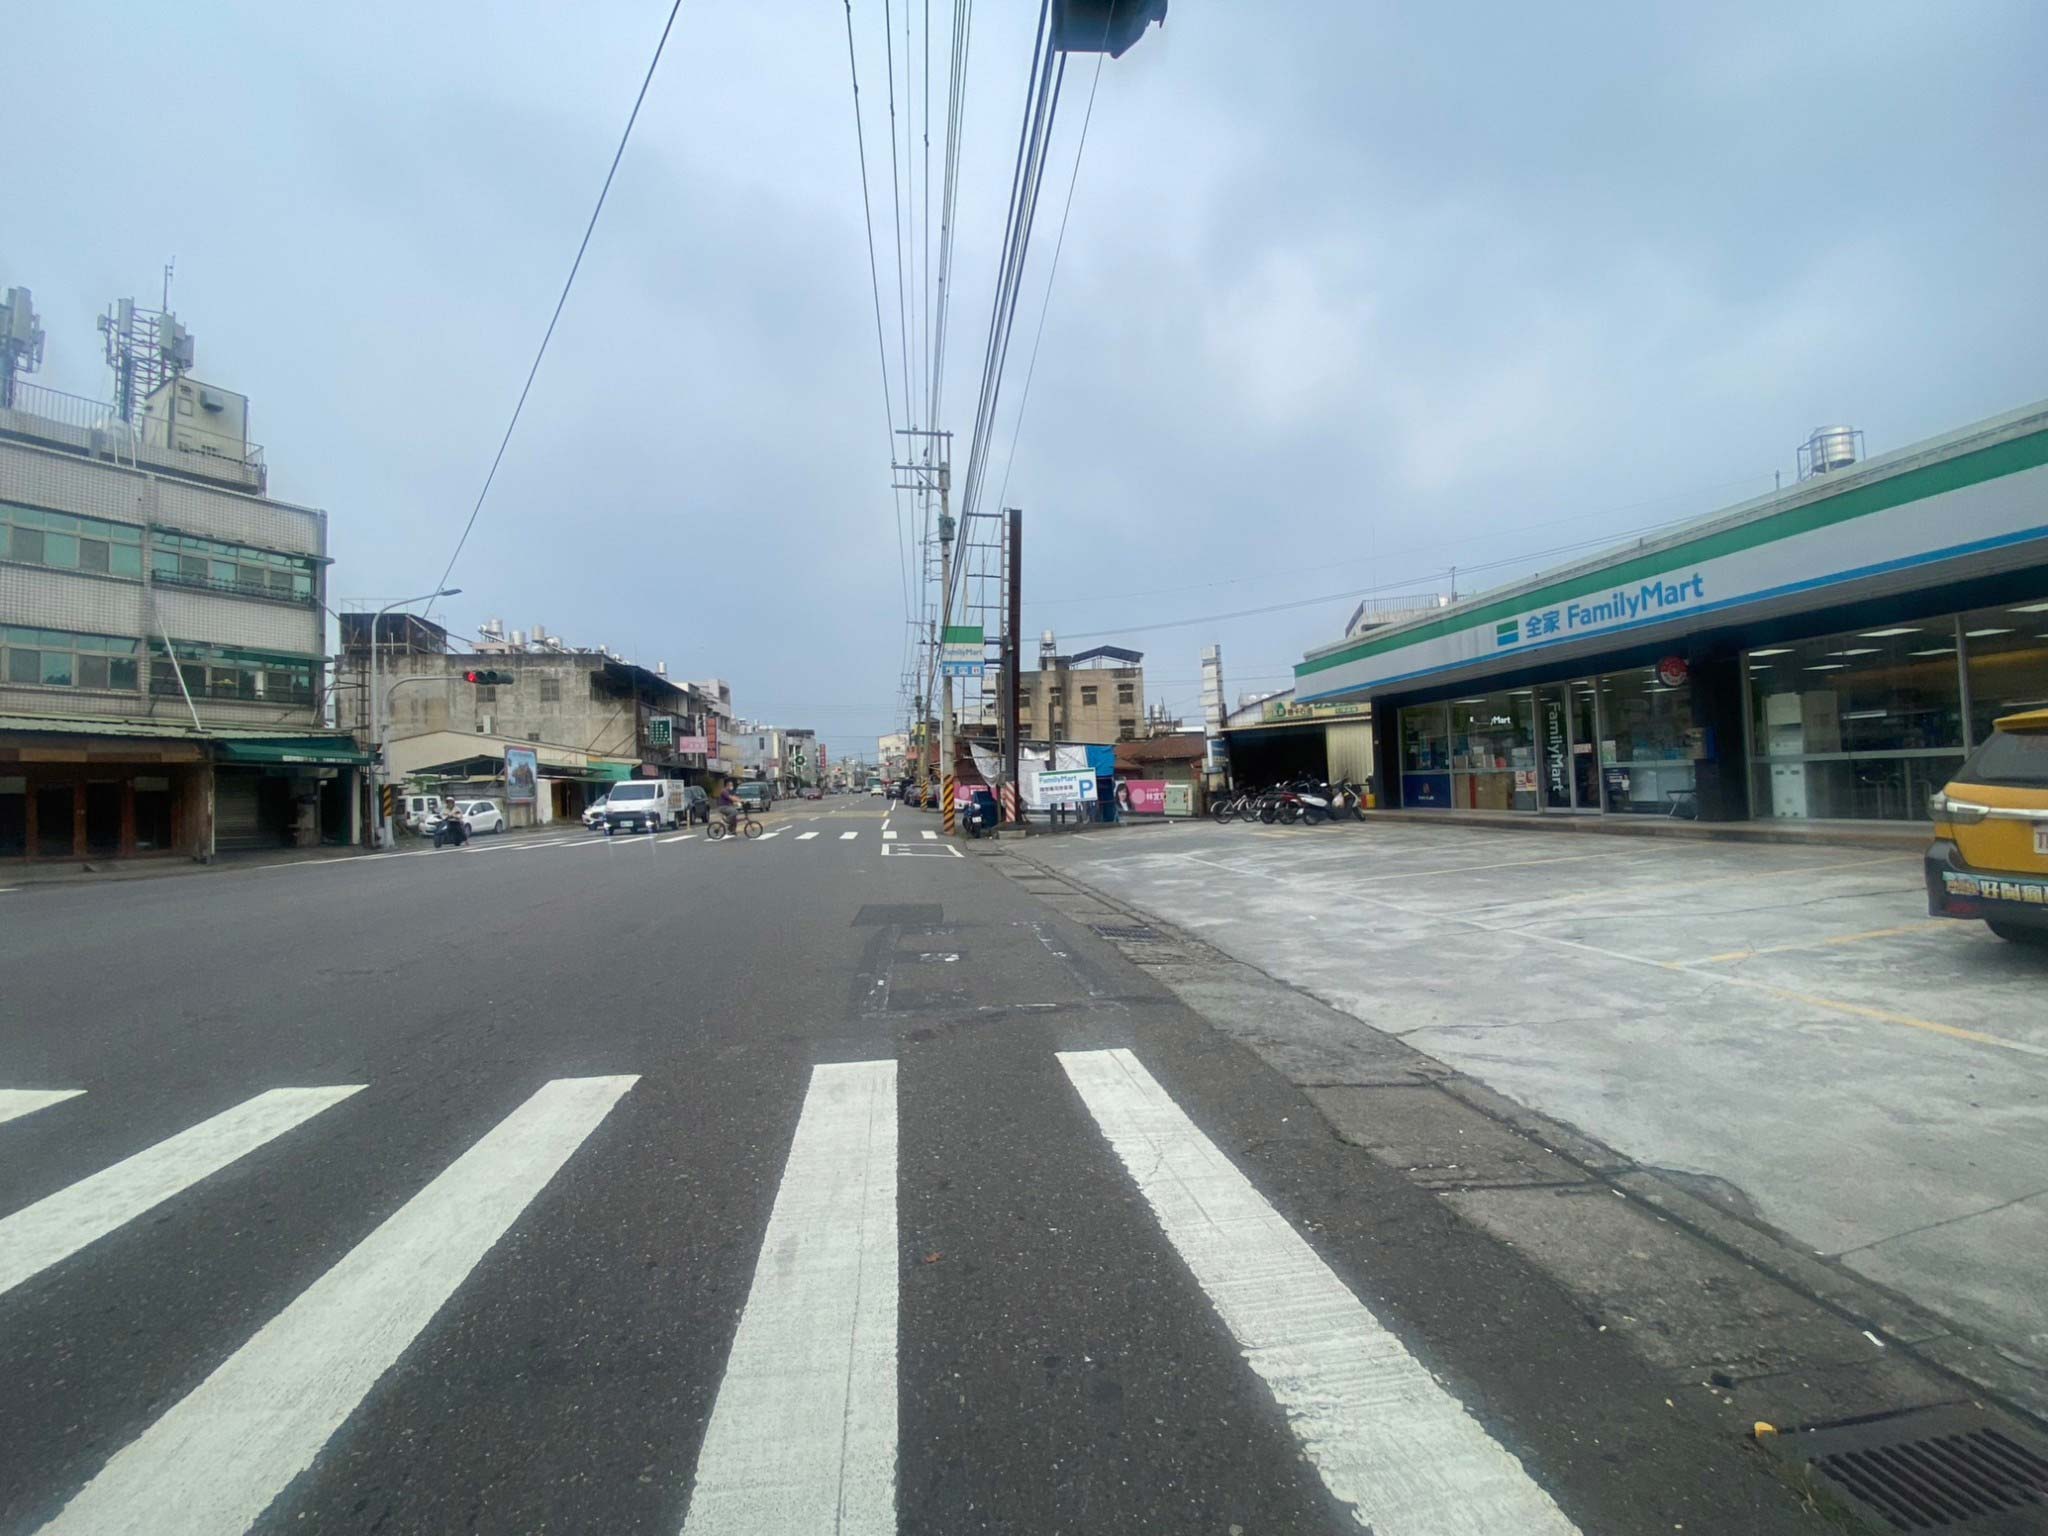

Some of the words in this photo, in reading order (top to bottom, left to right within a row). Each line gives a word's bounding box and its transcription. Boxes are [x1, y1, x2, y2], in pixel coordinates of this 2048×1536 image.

[1525, 610, 1560, 639] 全家
[1567, 573, 1704, 628] FamilyMart
[1547, 703, 1564, 792] FamilyMart
[1040, 775, 1077, 784] FamilyMart
[1079, 779, 1094, 799] P
